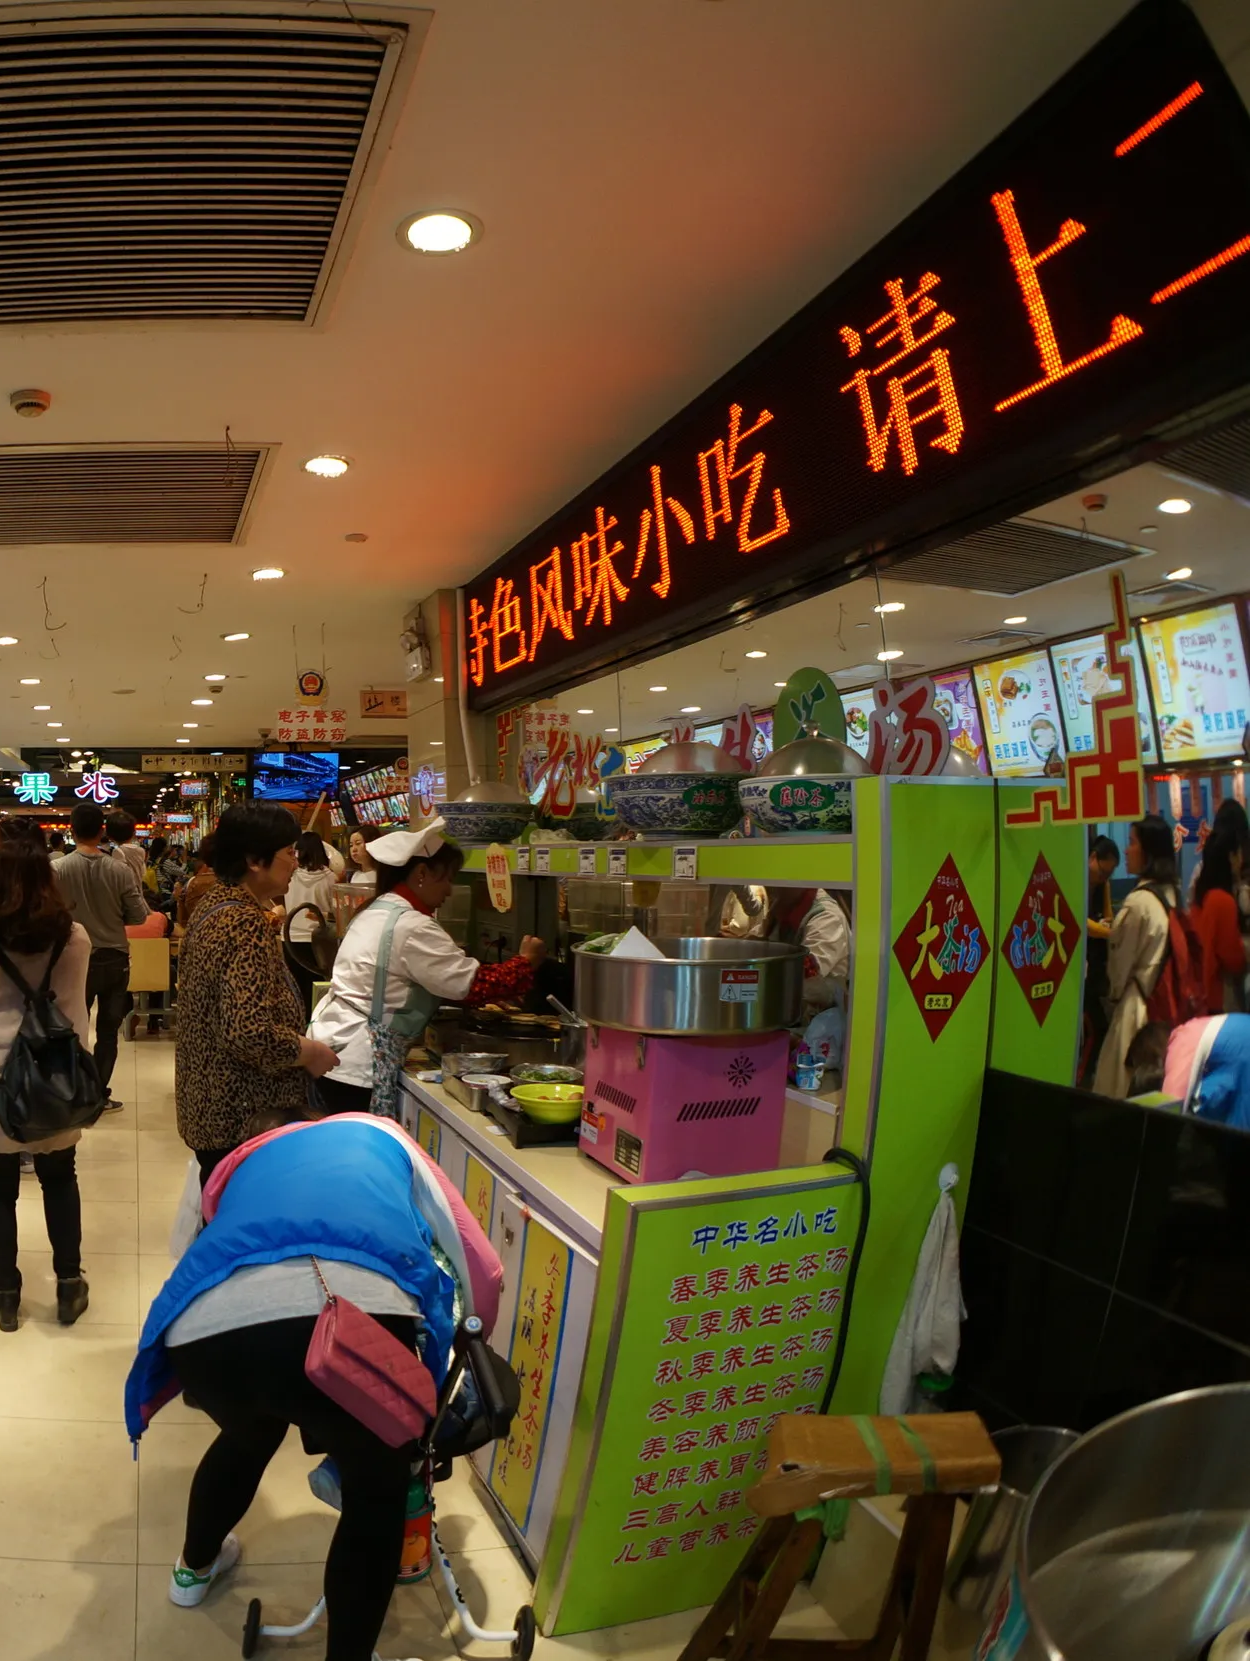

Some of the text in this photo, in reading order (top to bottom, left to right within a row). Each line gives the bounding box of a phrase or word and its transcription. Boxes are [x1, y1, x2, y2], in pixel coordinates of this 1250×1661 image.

[278, 709, 347, 724] 电子警察
[691, 1207, 838, 1255] 中华名小吃
[668, 1246, 851, 1305] 春季养生茶汤
[659, 1286, 843, 1347] 夏季养生茶汤
[654, 1327, 835, 1388] 秋季养生茶汤
[647, 1365, 827, 1425] 冬季养生茶汤
[621, 1487, 742, 1533] 三高人群
